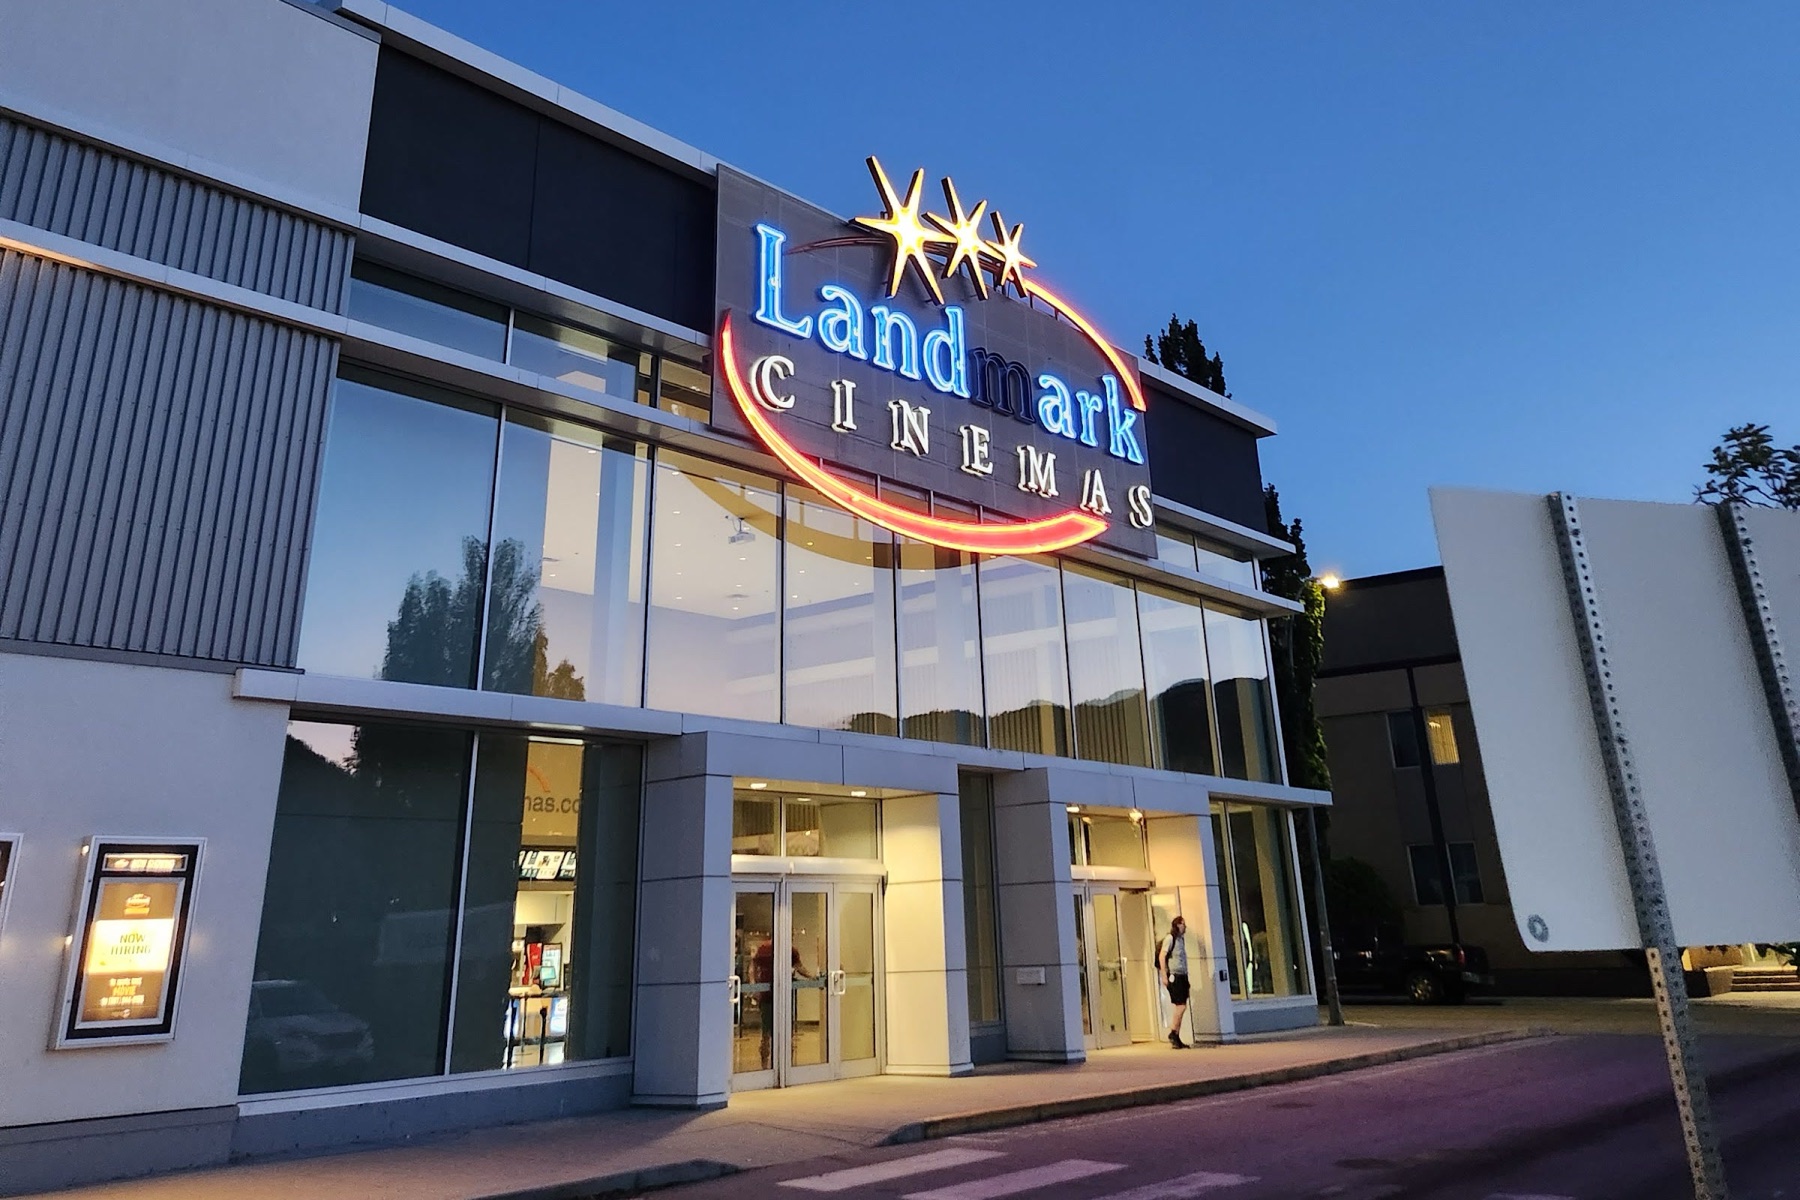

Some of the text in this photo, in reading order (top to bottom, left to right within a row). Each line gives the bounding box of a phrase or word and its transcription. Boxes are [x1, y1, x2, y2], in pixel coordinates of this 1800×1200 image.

[755, 223, 1145, 465] Landmark
[751, 354, 1153, 529] CINEMAS
[110, 945, 151, 956] HIRING
[119, 933, 146, 944] NOW
